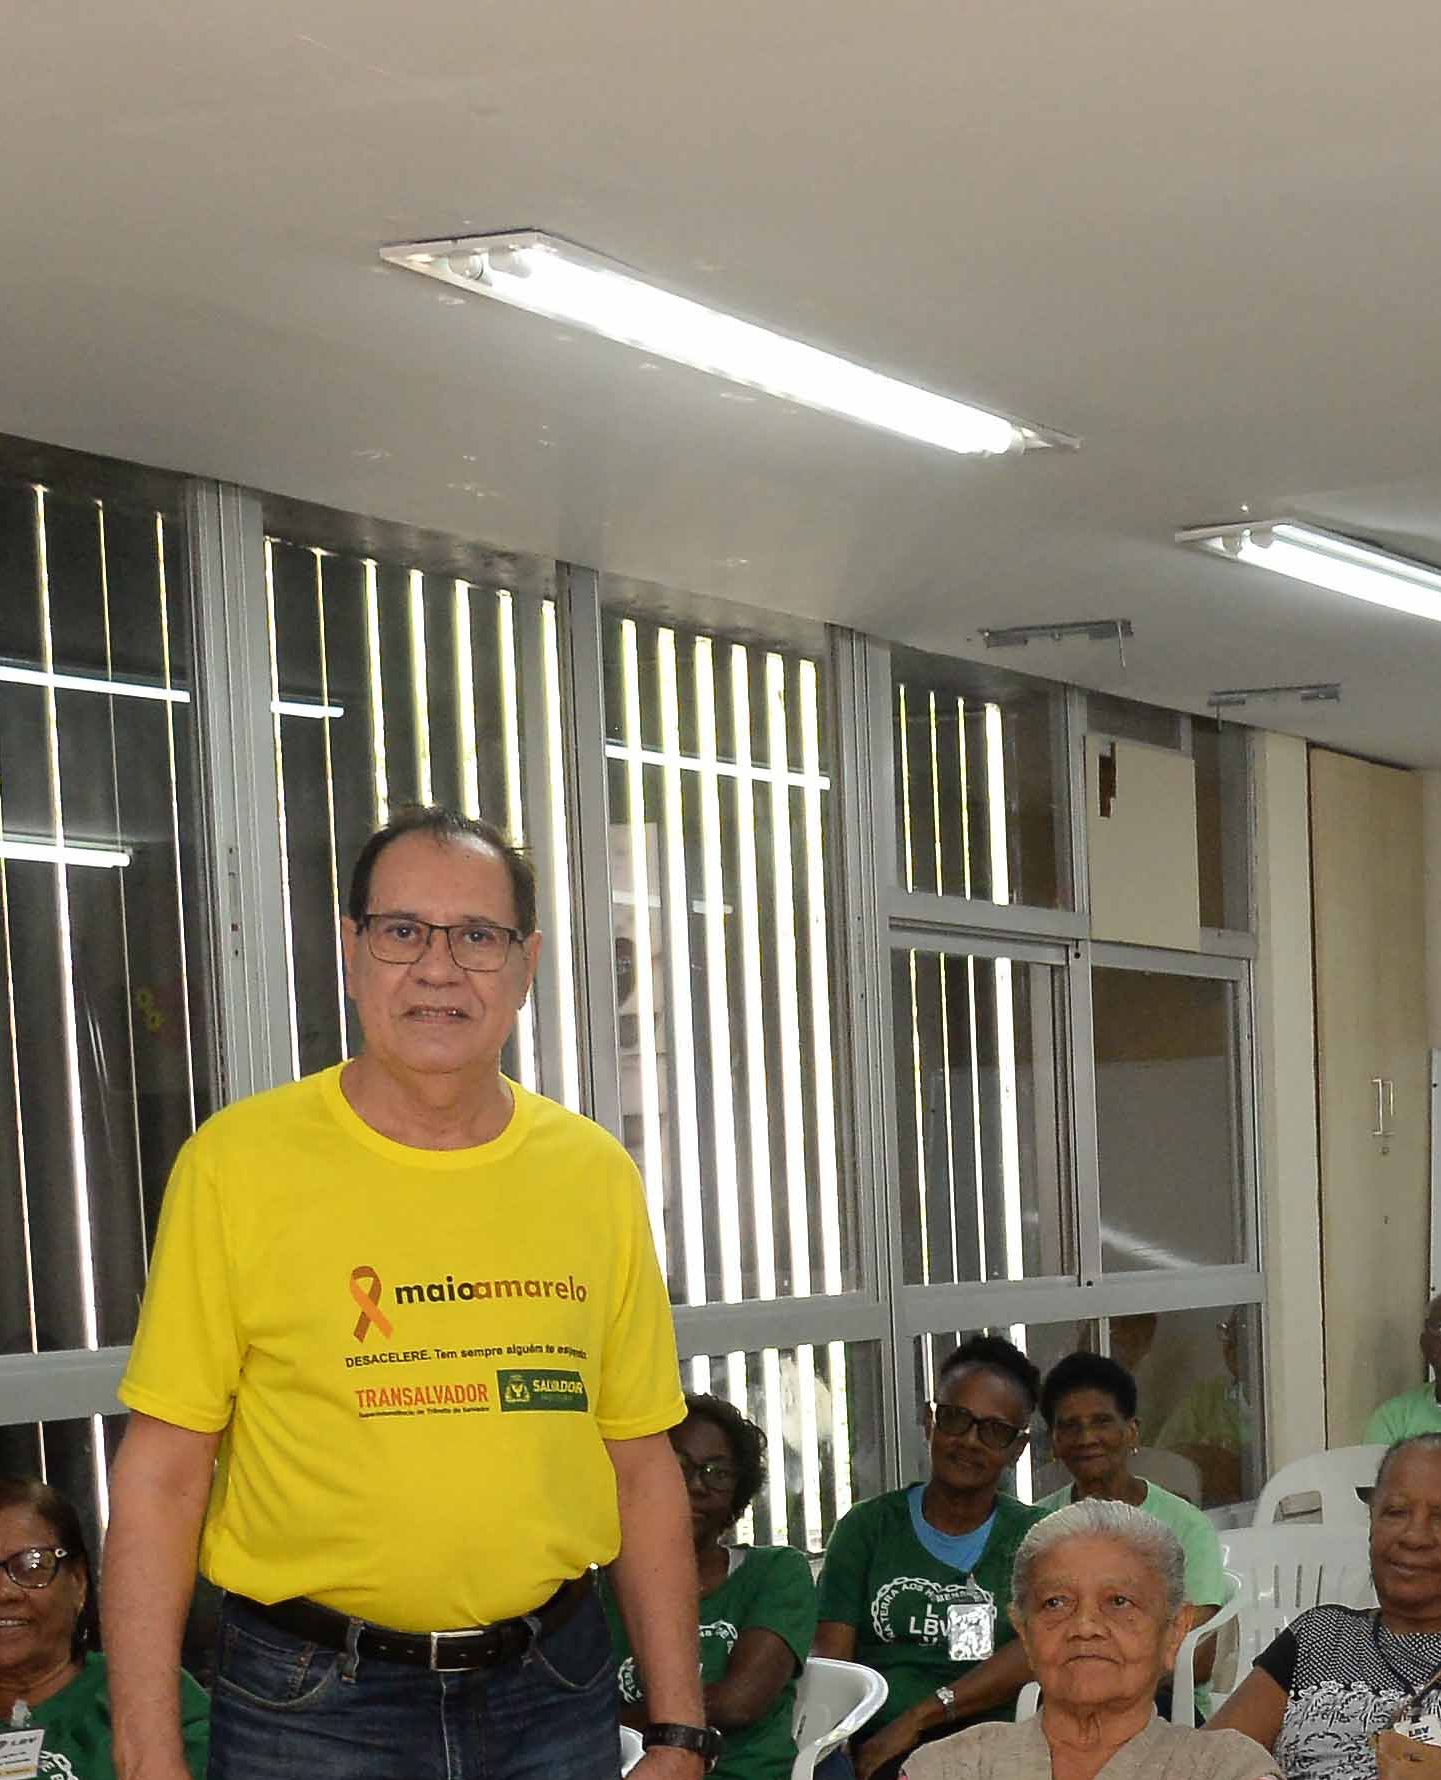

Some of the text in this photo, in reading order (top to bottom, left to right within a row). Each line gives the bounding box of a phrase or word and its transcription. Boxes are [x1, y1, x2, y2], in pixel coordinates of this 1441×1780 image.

[394, 1274, 587, 1305] maioamarelo
[345, 1349, 431, 1368] DESACELERE.
[434, 1349, 457, 1360] Tem
[460, 1346, 503, 1360] sempre
[506, 1343, 543, 1356] alguém
[546, 1344, 555, 1354] te
[354, 1383, 489, 1409] TRANSALVADOR
[532, 1379, 584, 1394] SALVADOR
[901, 1583, 924, 1592] AOS
[909, 1616, 950, 1637] LBV
